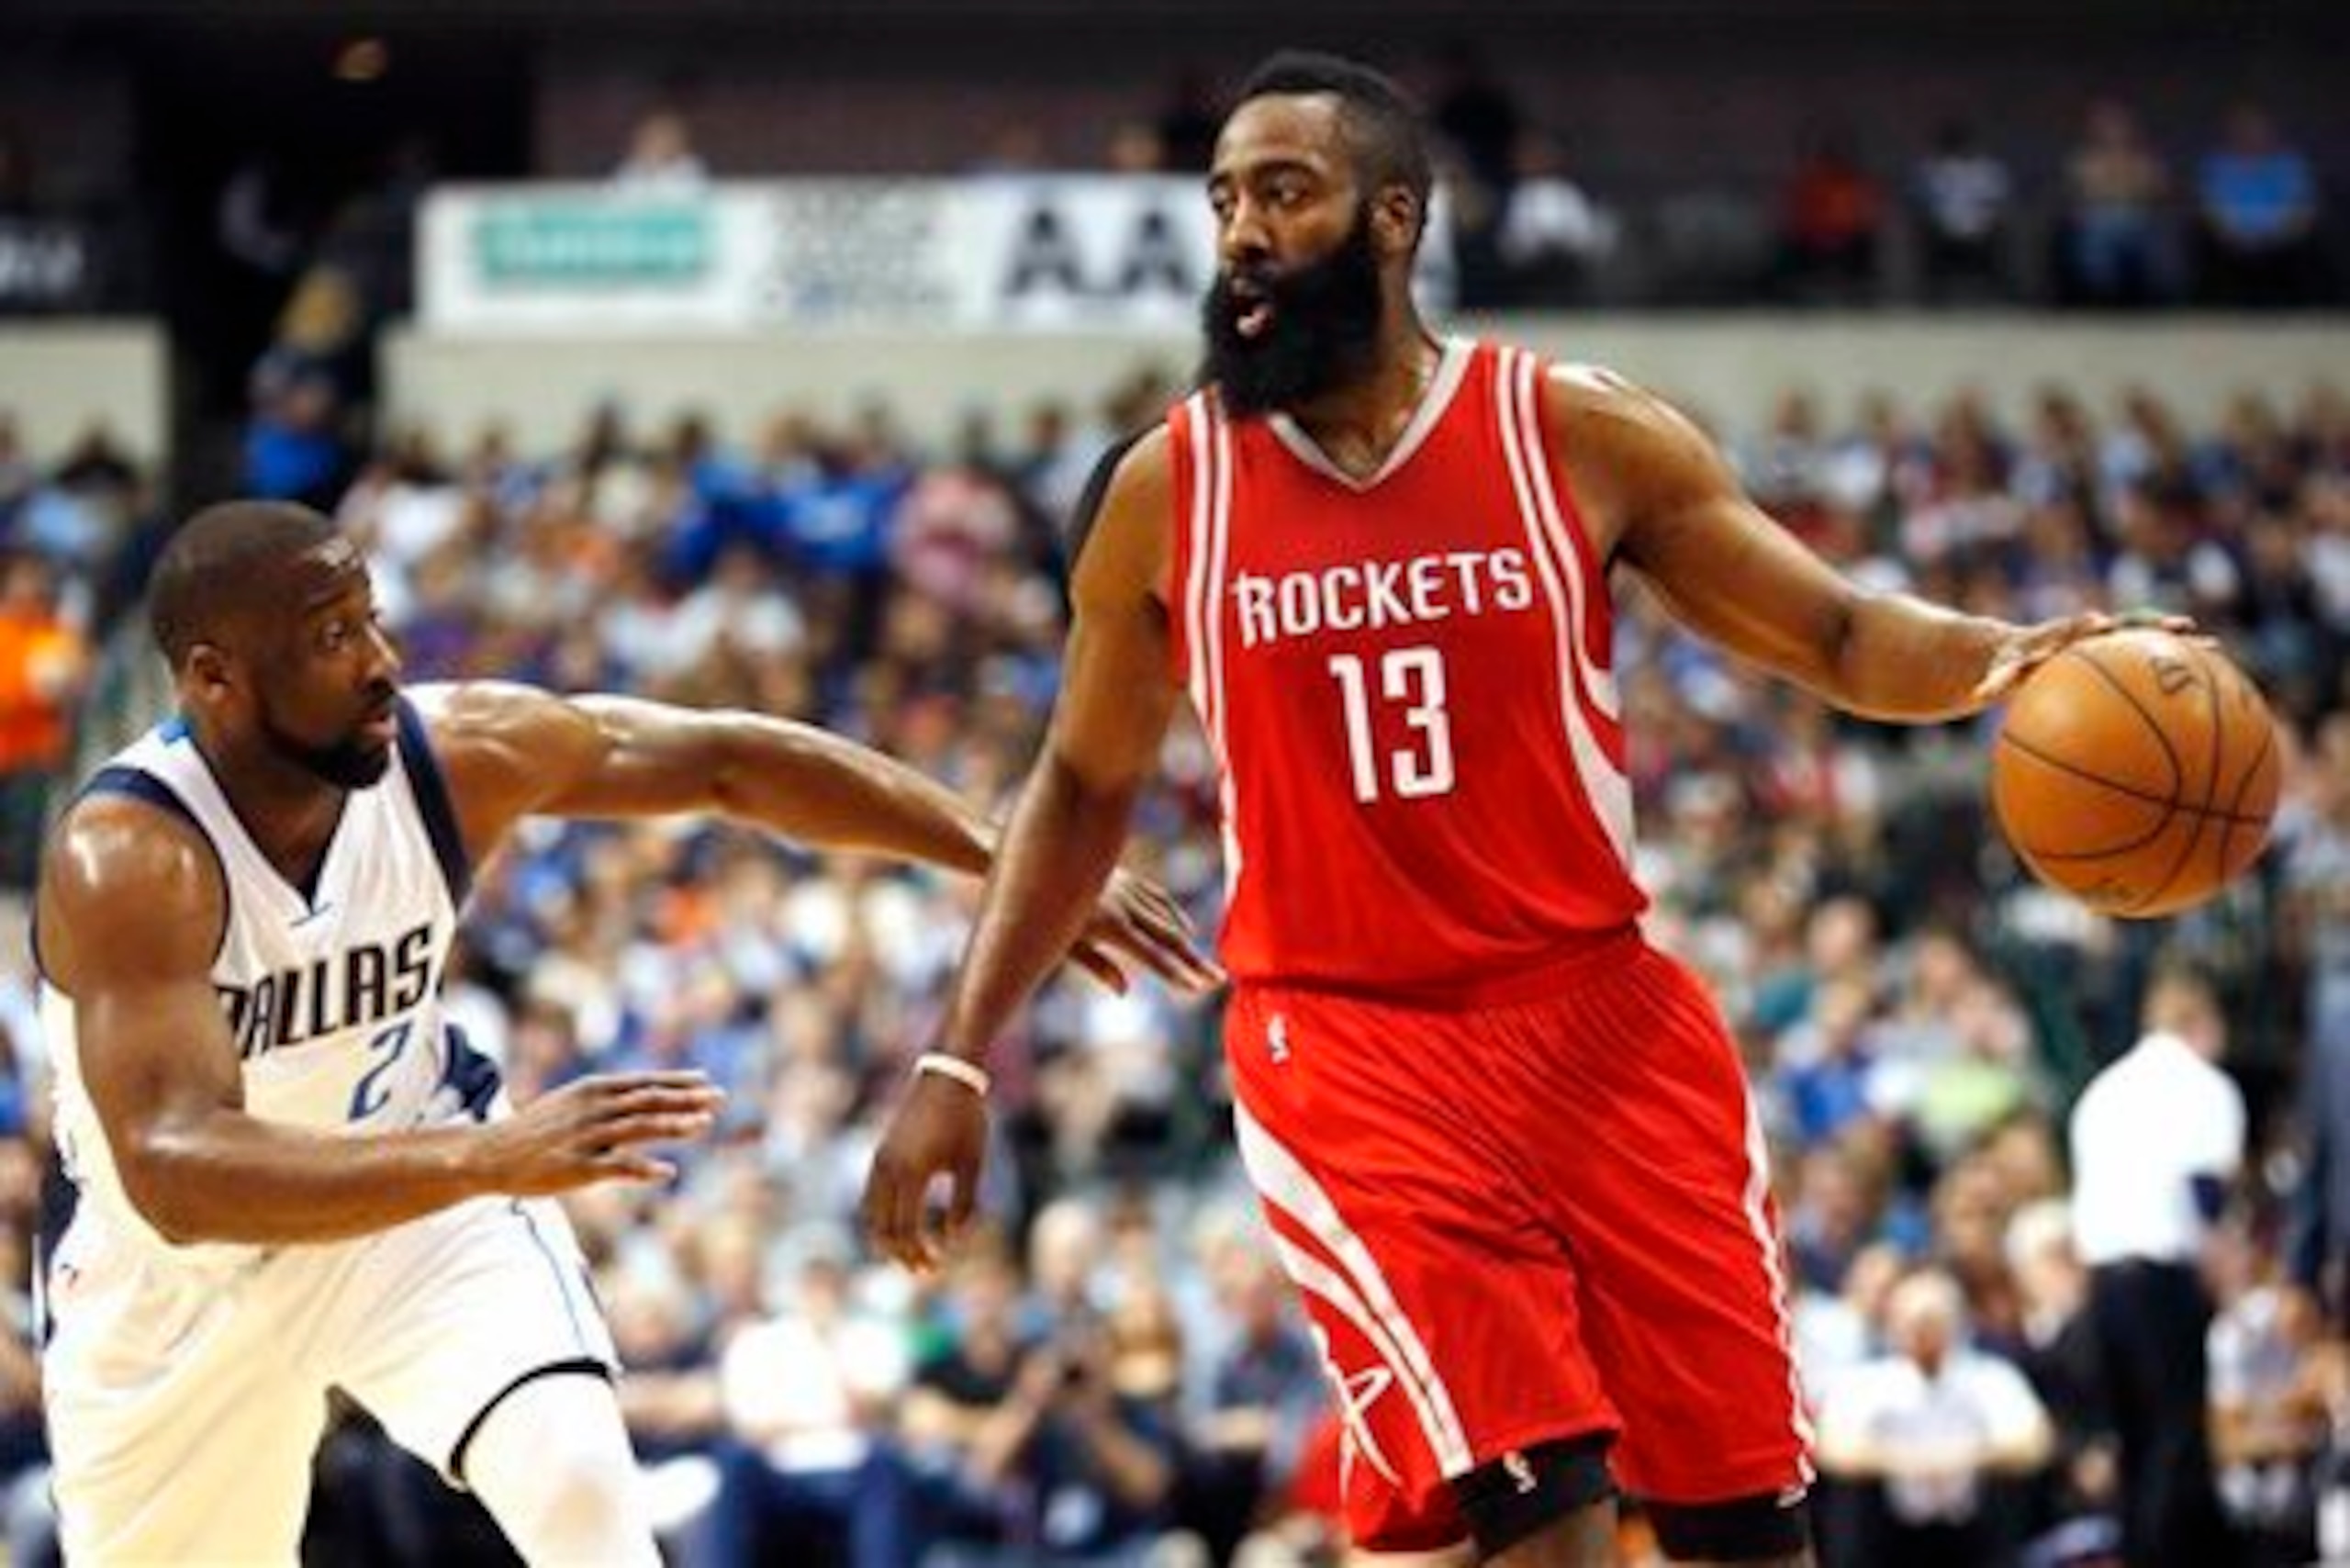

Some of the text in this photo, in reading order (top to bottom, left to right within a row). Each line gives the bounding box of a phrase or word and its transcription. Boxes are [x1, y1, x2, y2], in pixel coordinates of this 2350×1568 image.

[1234, 547, 1533, 648] ROCKETS
[1328, 645, 1454, 803] 13
[348, 1021, 412, 1122] 2
